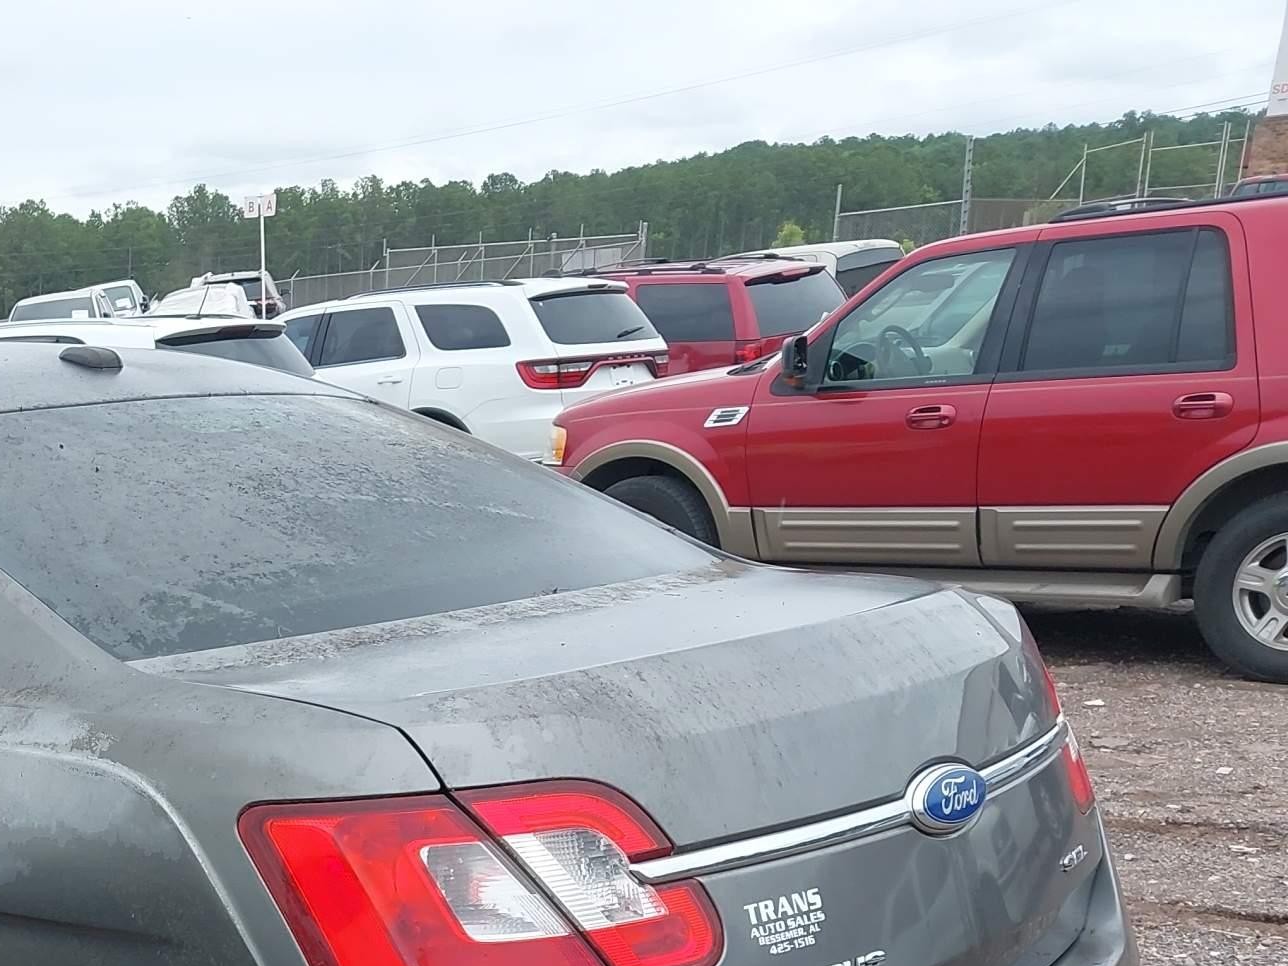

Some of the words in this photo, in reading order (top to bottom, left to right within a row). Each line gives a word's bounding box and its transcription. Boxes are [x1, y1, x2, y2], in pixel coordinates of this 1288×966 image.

[941, 775, 979, 815] Ford
[743, 887, 823, 925] TRANS
[750, 920, 786, 939] AUTO
[787, 910, 826, 930] SALES
[809, 923, 821, 934] AL
[769, 934, 816, 955] 425-1516
